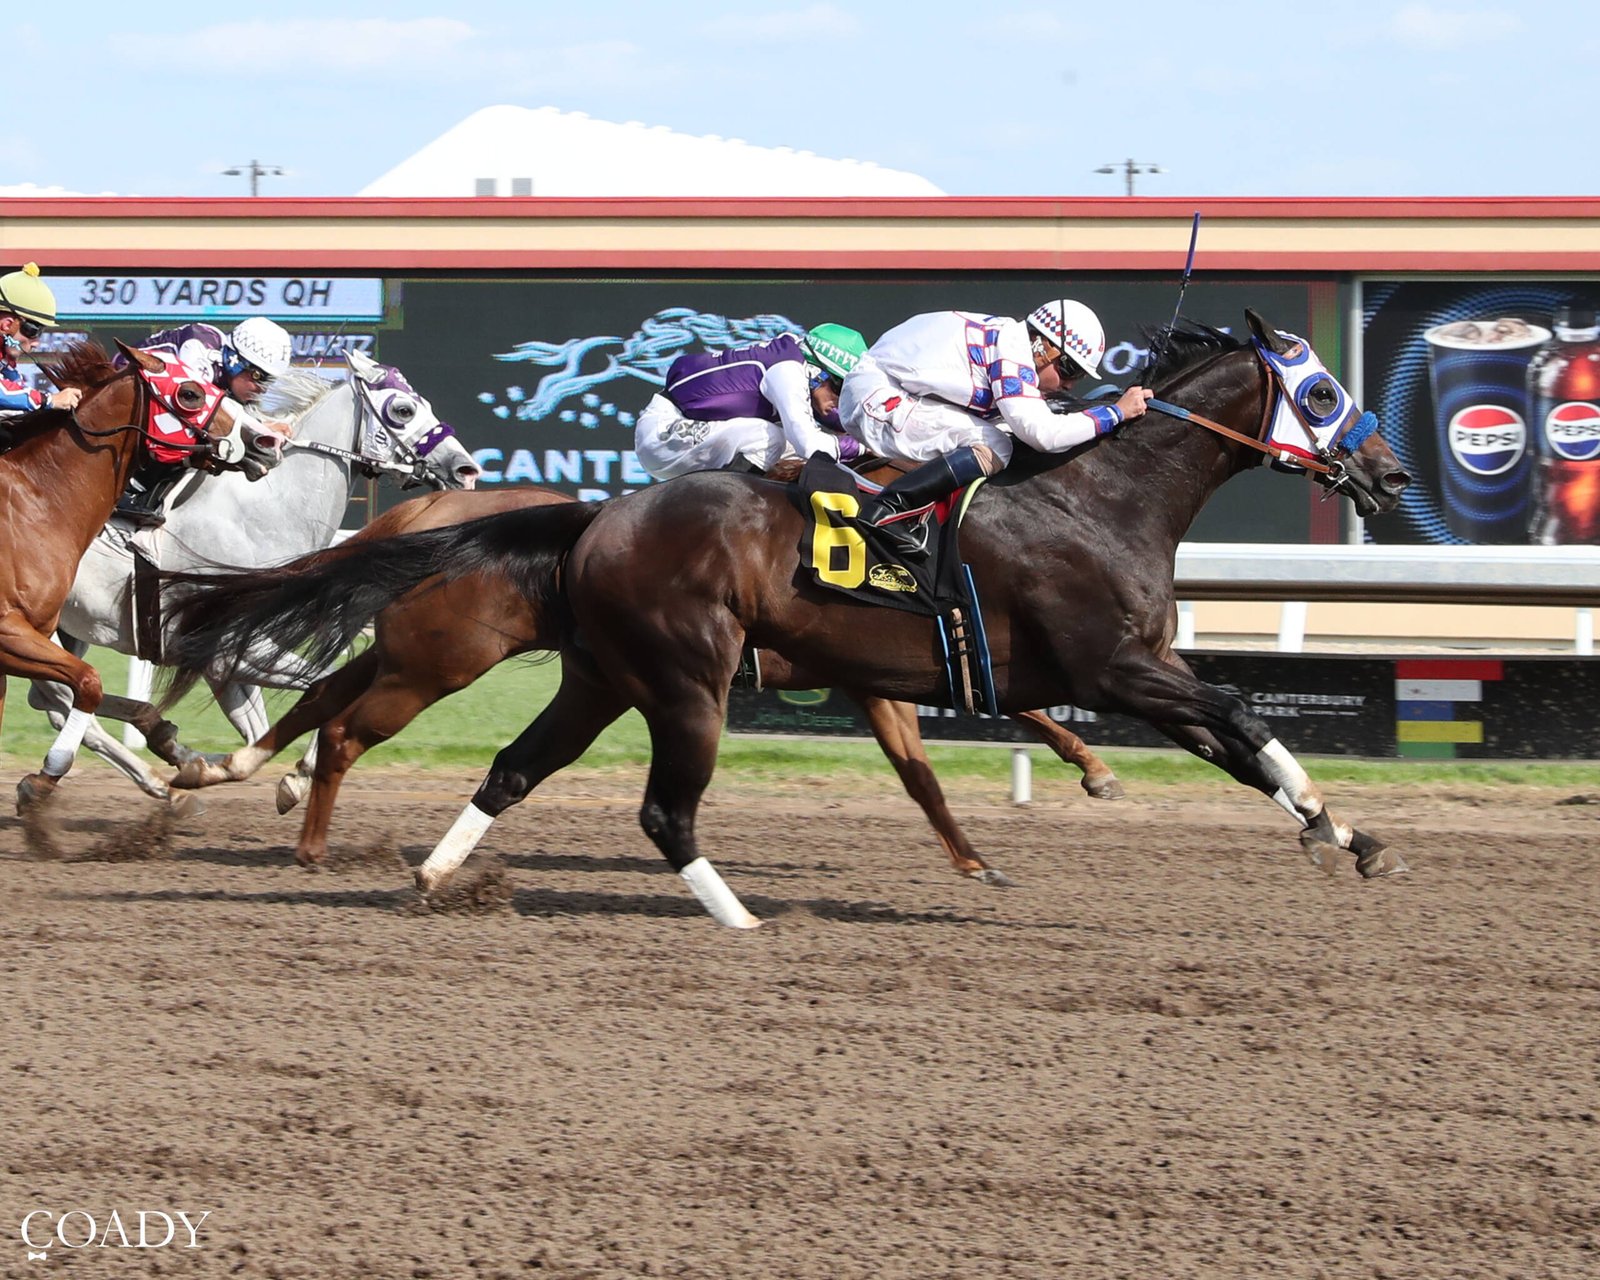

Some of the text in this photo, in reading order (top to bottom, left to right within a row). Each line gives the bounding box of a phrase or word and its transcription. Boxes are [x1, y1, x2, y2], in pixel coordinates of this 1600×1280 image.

[80, 279, 333, 308] 350 YARDS QH
[1456, 430, 1520, 447] PEPSI
[472, 447, 656, 484] CANTE
[810, 490, 867, 589] 6
[1250, 692, 1367, 706] CANTERBURY
[1251, 705, 1300, 718] PARK
